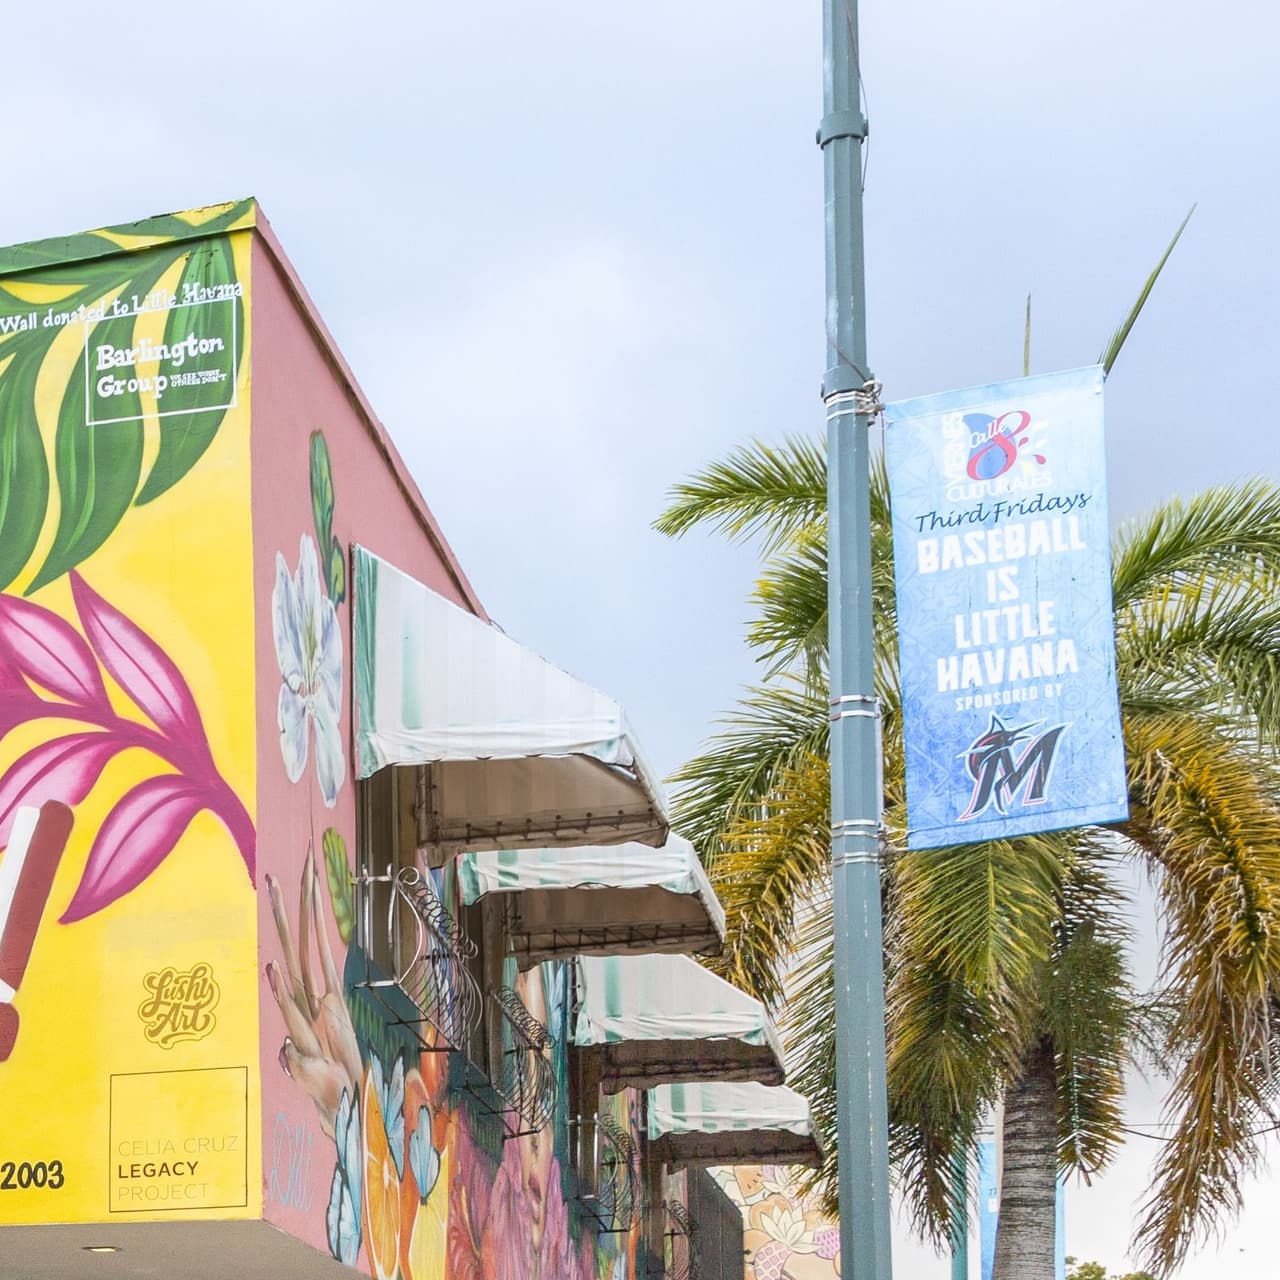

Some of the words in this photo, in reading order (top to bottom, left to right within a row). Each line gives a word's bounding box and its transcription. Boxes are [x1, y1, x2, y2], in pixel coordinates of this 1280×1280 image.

[43, 302, 105, 328] donated
[112, 299, 129, 316] to
[182, 281, 243, 304] Havana
[96, 332, 225, 371] Barlington
[97, 374, 168, 399] Group
[915, 503, 991, 533] Third
[993, 493, 1092, 524] Fridays
[917, 515, 1088, 576] BASEBALL
[988, 565, 1020, 603] IS
[955, 600, 1057, 649] LITTLE
[936, 639, 1080, 692] HAVANA
[956, 685, 1038, 712] SPONSORED
[1045, 682, 1063, 698] BY
[146, 1001, 211, 1044] Art
[118, 1138, 177, 1157] CELIA
[183, 1135, 239, 1154] CRUZ
[117, 1160, 199, 1179] LEGACY
[117, 1183, 209, 1201] PROJECT
